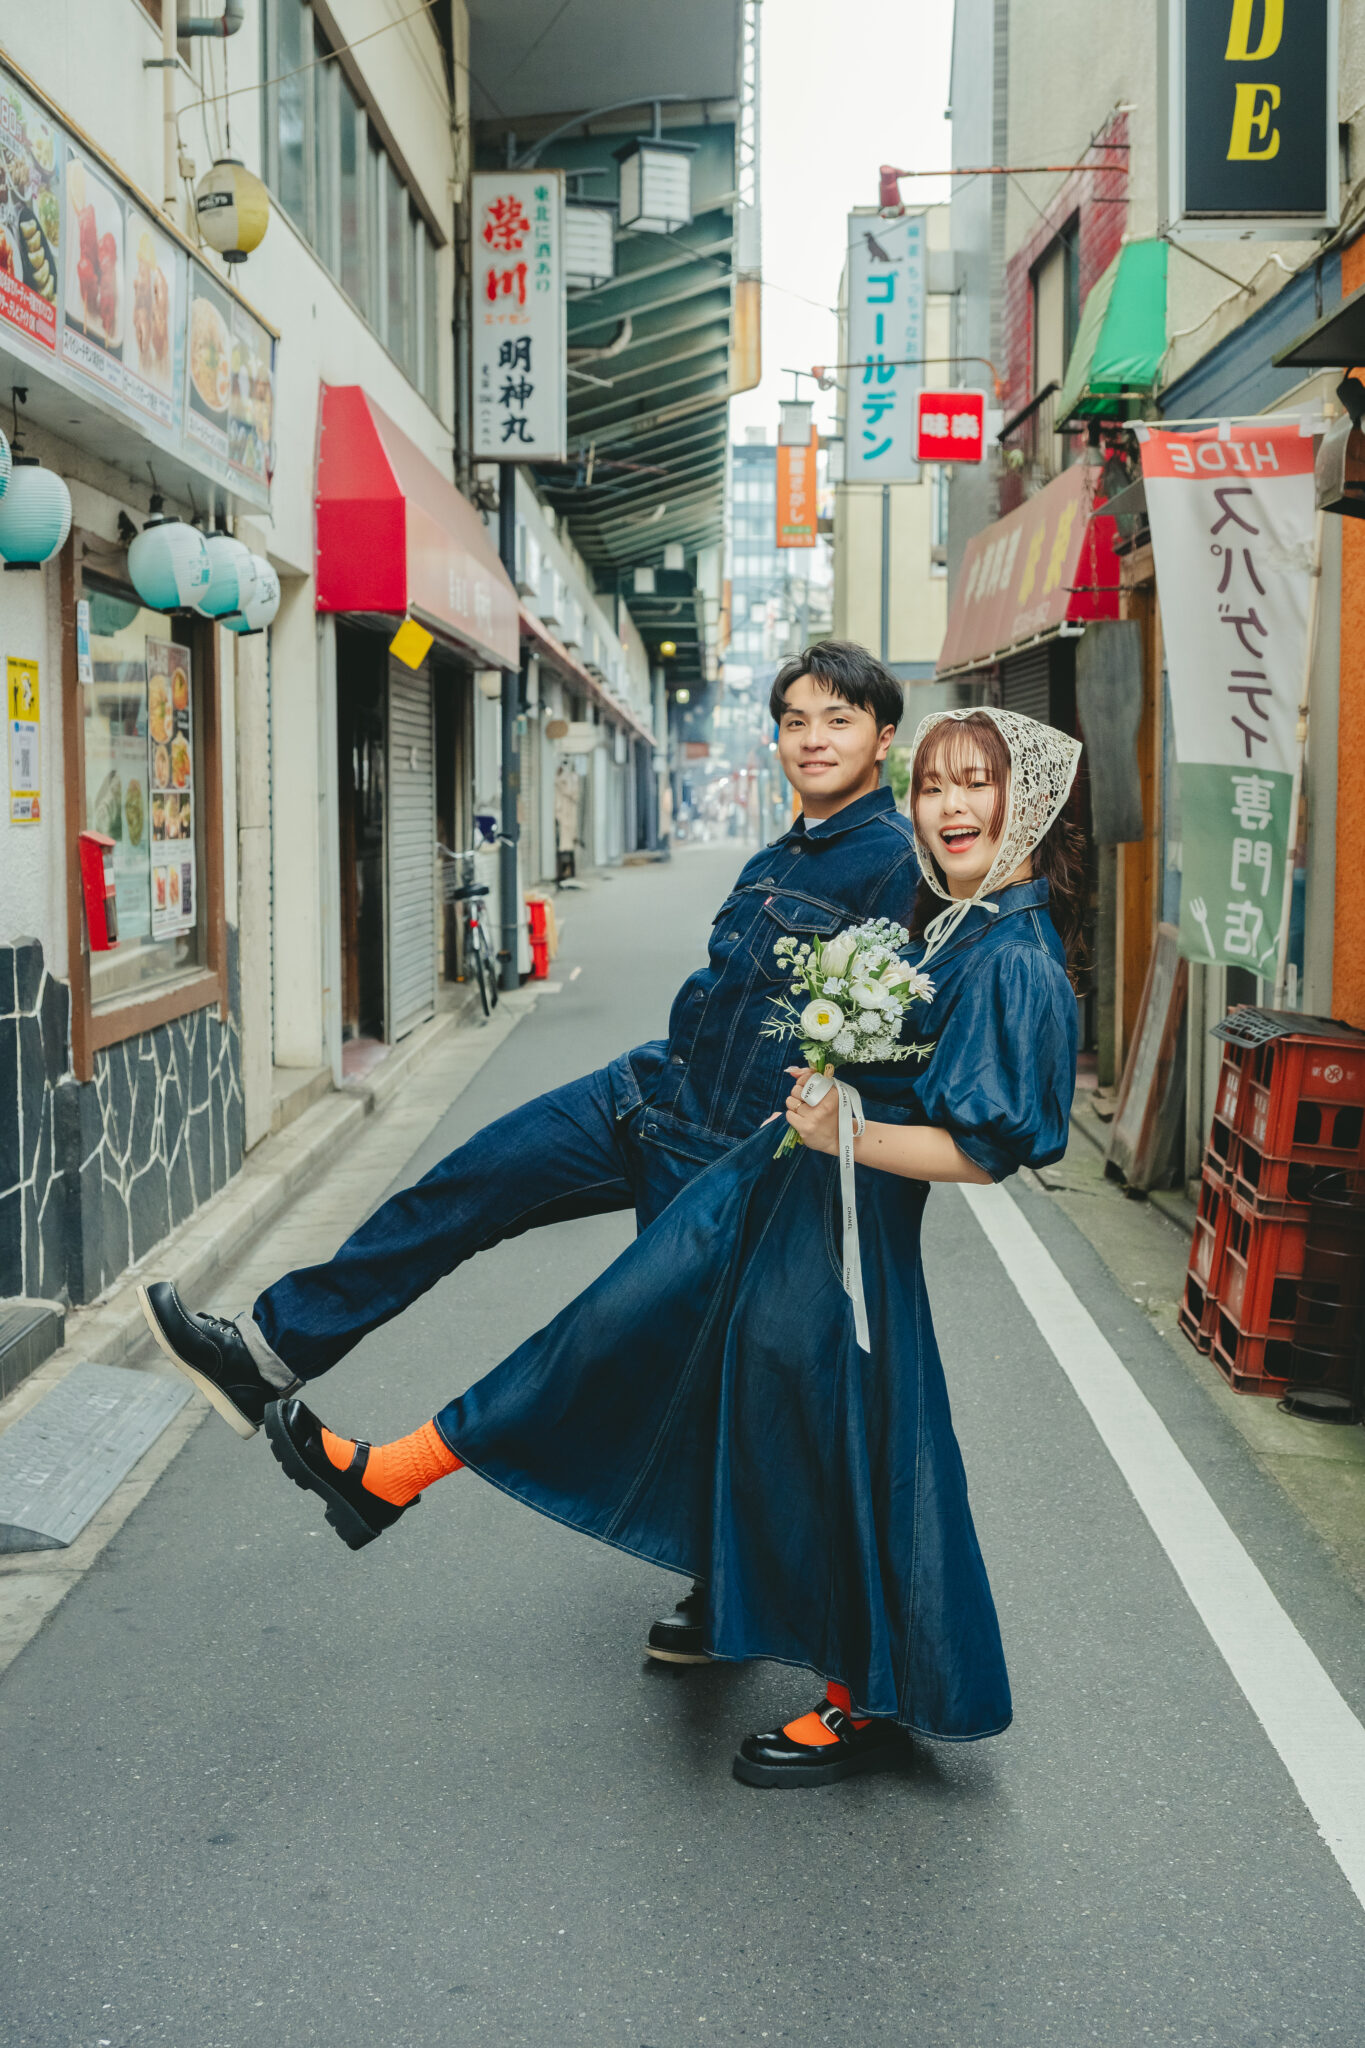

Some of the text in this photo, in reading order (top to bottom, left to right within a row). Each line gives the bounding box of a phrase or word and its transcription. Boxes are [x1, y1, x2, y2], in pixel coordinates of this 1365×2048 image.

[498, 335, 535, 443] 明神丸
[861, 270, 899, 460] ゴールデン
